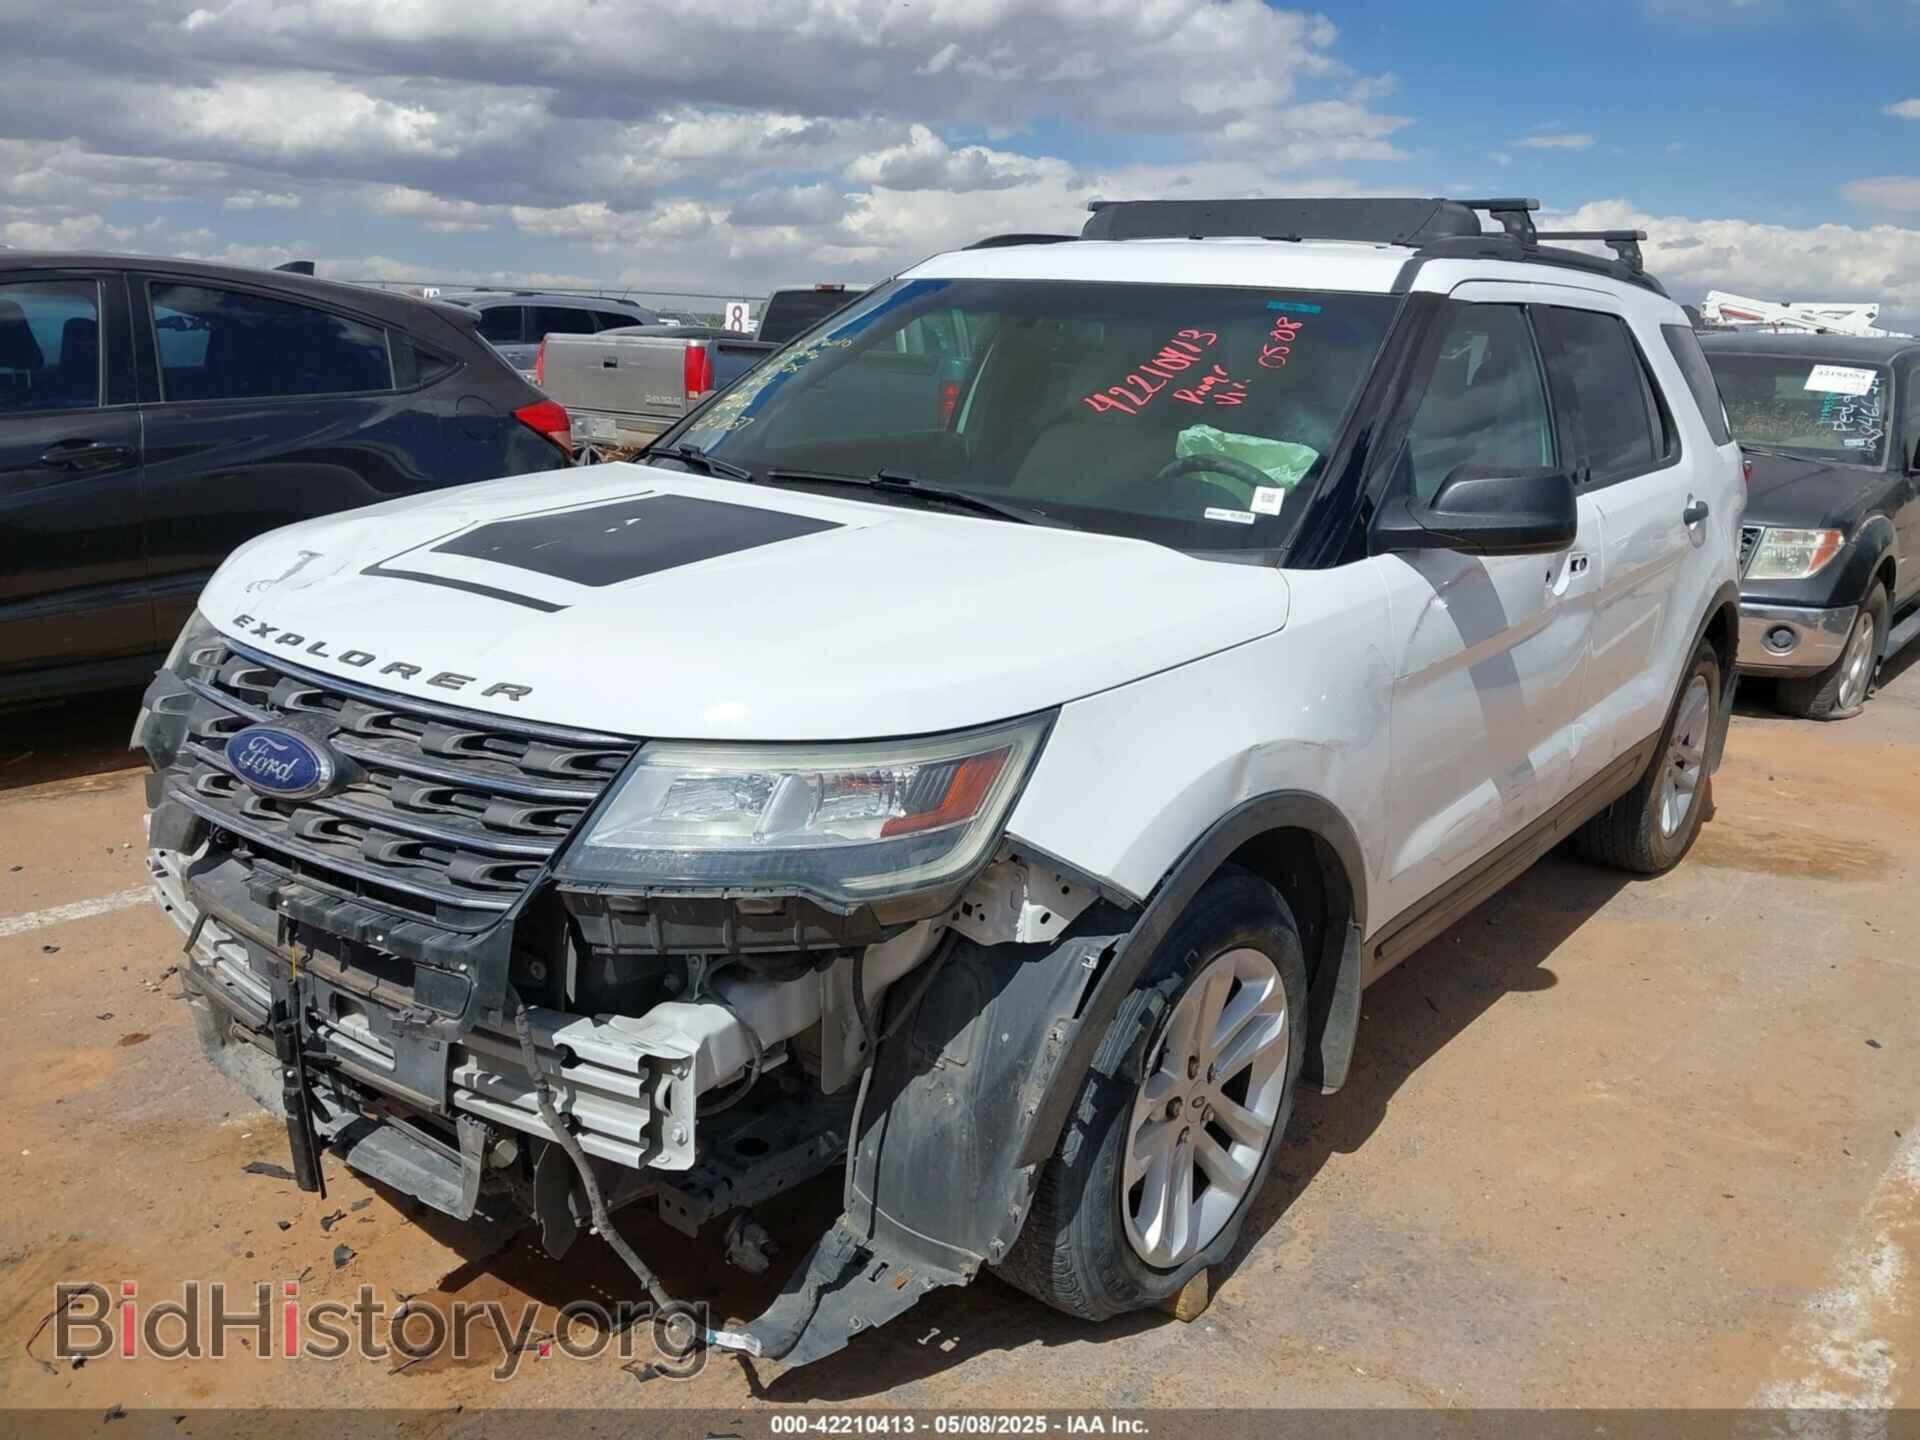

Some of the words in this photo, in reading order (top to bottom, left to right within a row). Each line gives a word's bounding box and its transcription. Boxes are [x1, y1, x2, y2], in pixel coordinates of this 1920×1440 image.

[731, 305, 743, 332] 8
[232, 614, 533, 701] EXPLORER
[238, 736, 300, 782] Ford
